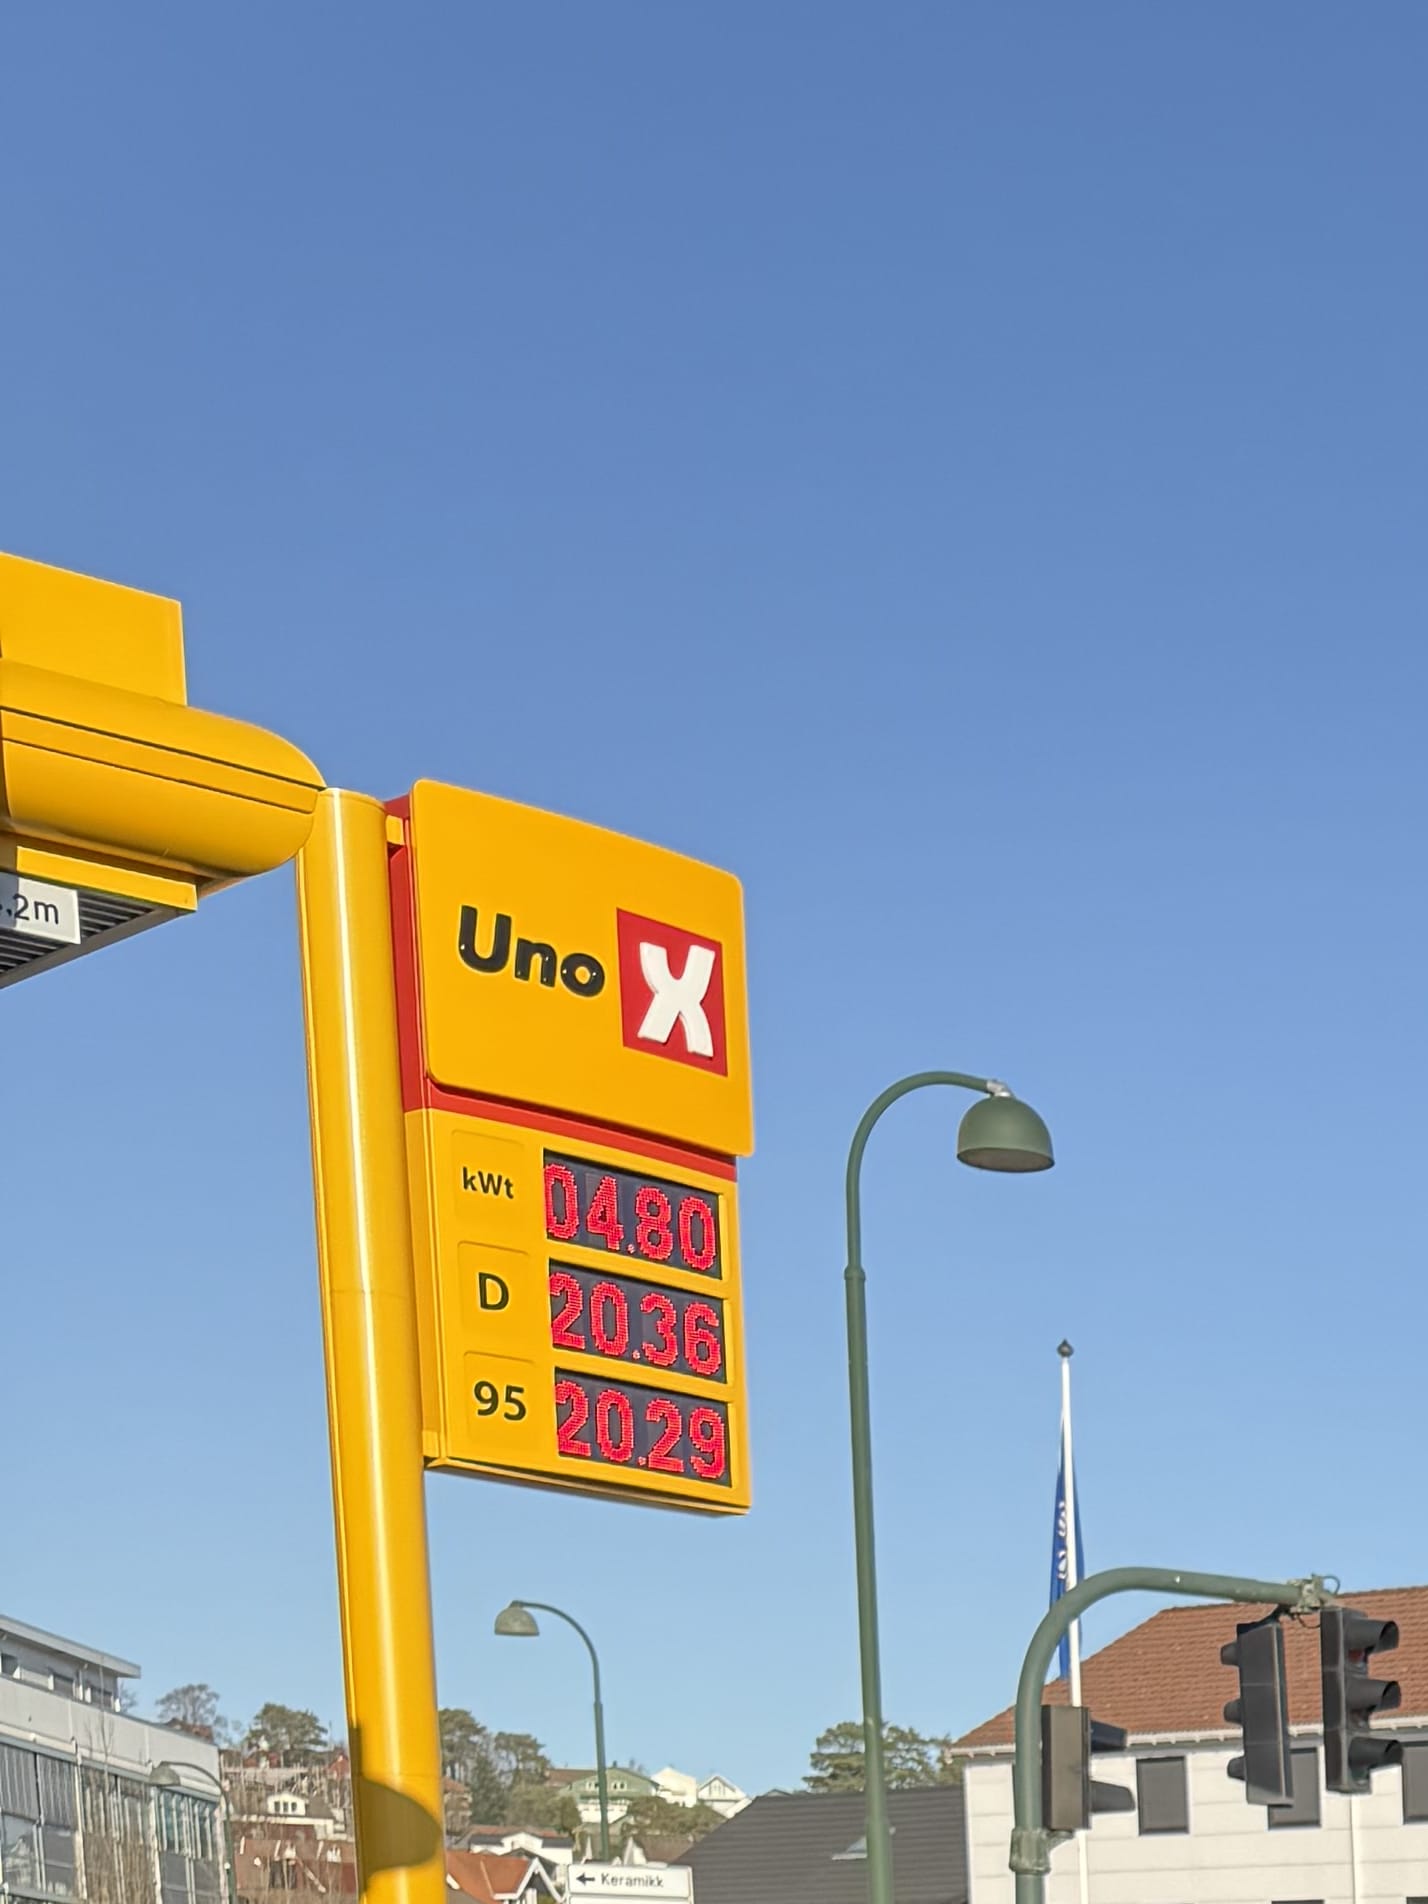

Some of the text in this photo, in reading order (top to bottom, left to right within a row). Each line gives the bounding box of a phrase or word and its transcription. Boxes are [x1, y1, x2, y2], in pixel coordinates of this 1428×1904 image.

[0, 893, 59, 925] .2m
[458, 904, 715, 1058] Uno X
[462, 1163, 716, 1270] kWt 04.80
[478, 1272, 722, 1375] D 20.36
[474, 1380, 725, 1479] 95 20.29
[601, 1873, 664, 1888] Keramikk
